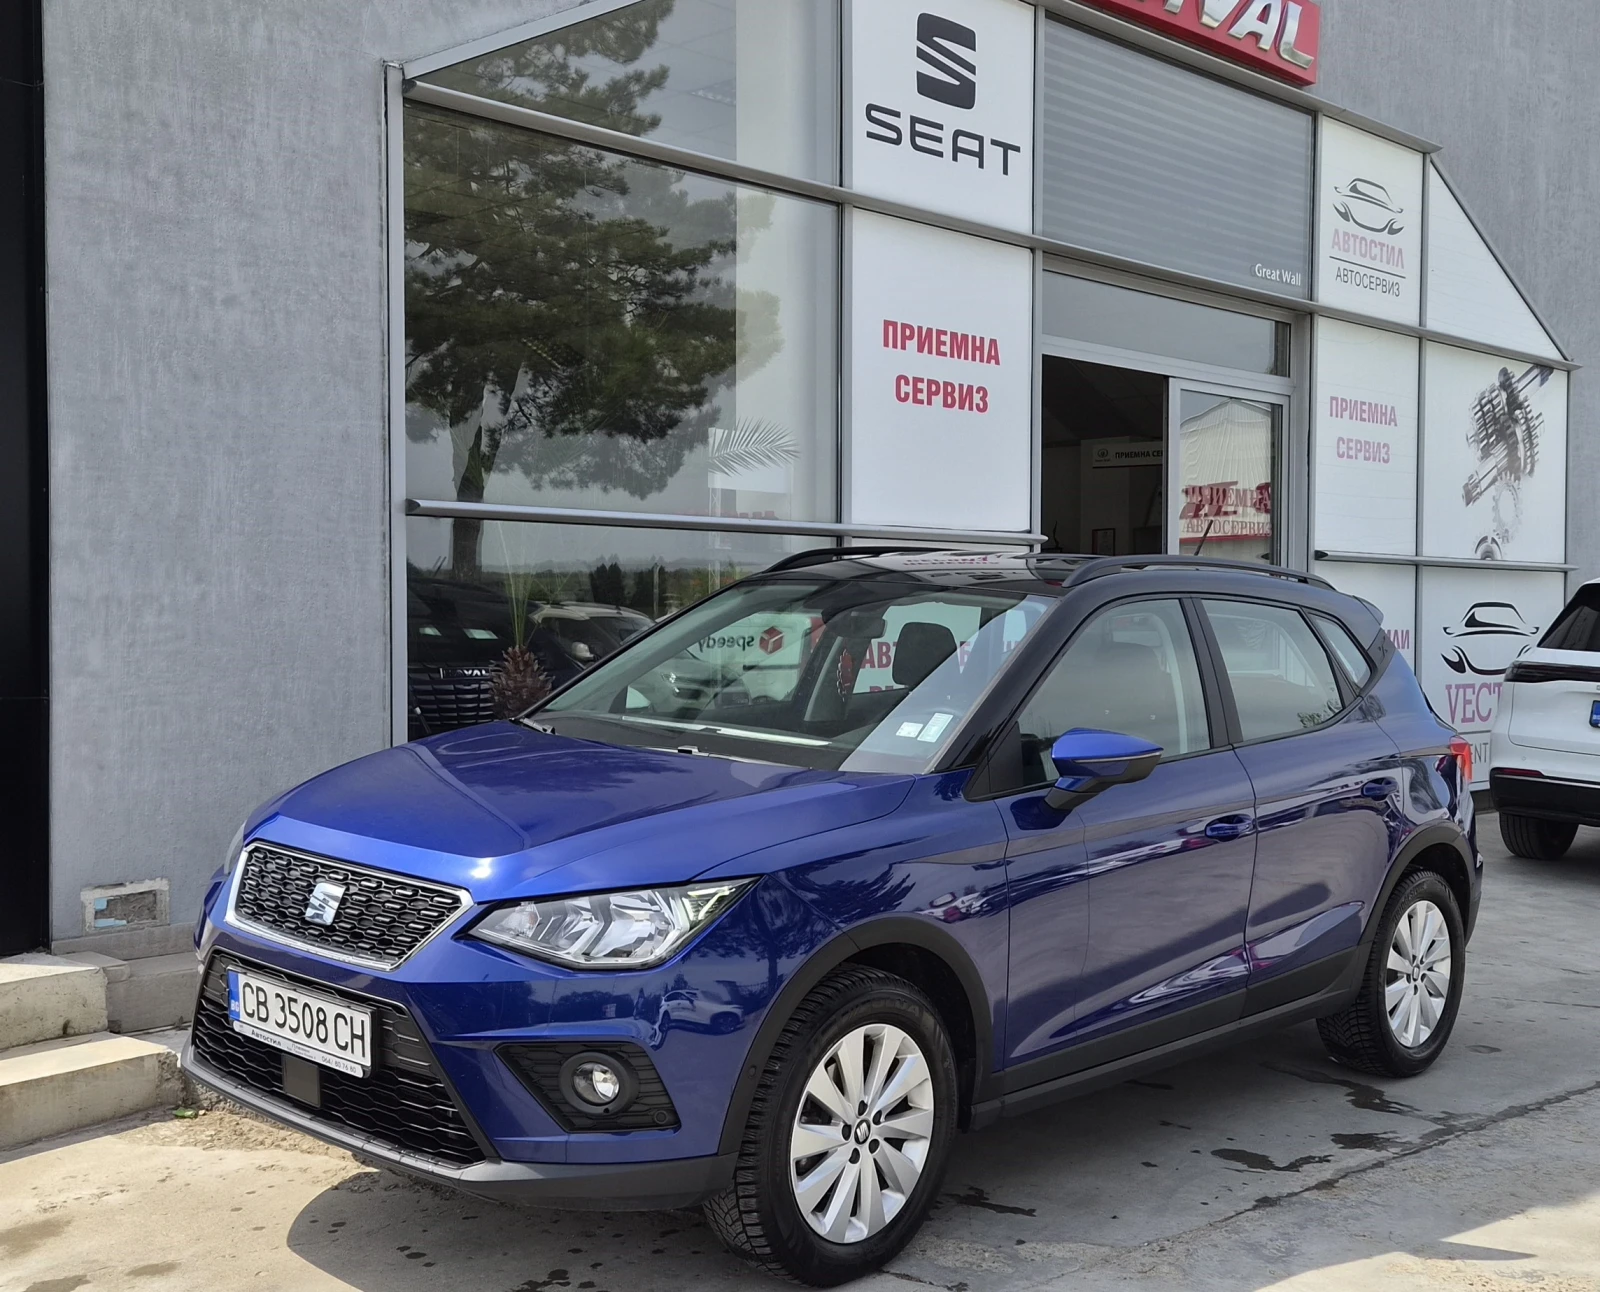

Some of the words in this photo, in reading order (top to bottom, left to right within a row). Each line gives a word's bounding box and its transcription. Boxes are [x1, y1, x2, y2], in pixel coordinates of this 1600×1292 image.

[1136, 0, 1315, 69] VAL
[865, 103, 1021, 176] SEAT
[1331, 228, 1404, 269] АВТОСТИЛ
[1255, 263, 1280, 282] Great
[1281, 269, 1301, 287] Wall
[1335, 266, 1400, 297] АВТОСЕРВИЗ
[883, 319, 1000, 366] ПРИЕМНА
[895, 374, 988, 413] СЕРВИЗ
[1329, 395, 1398, 427] ПРИЕМНА
[1115, 450, 1150, 459] ПРИЕМНА
[1336, 436, 1390, 464] СЕРВИЗ
[1445, 682, 1503, 725] VECT
[230, 1000, 240, 1012] BG
[274, 992, 328, 1043] 3508
